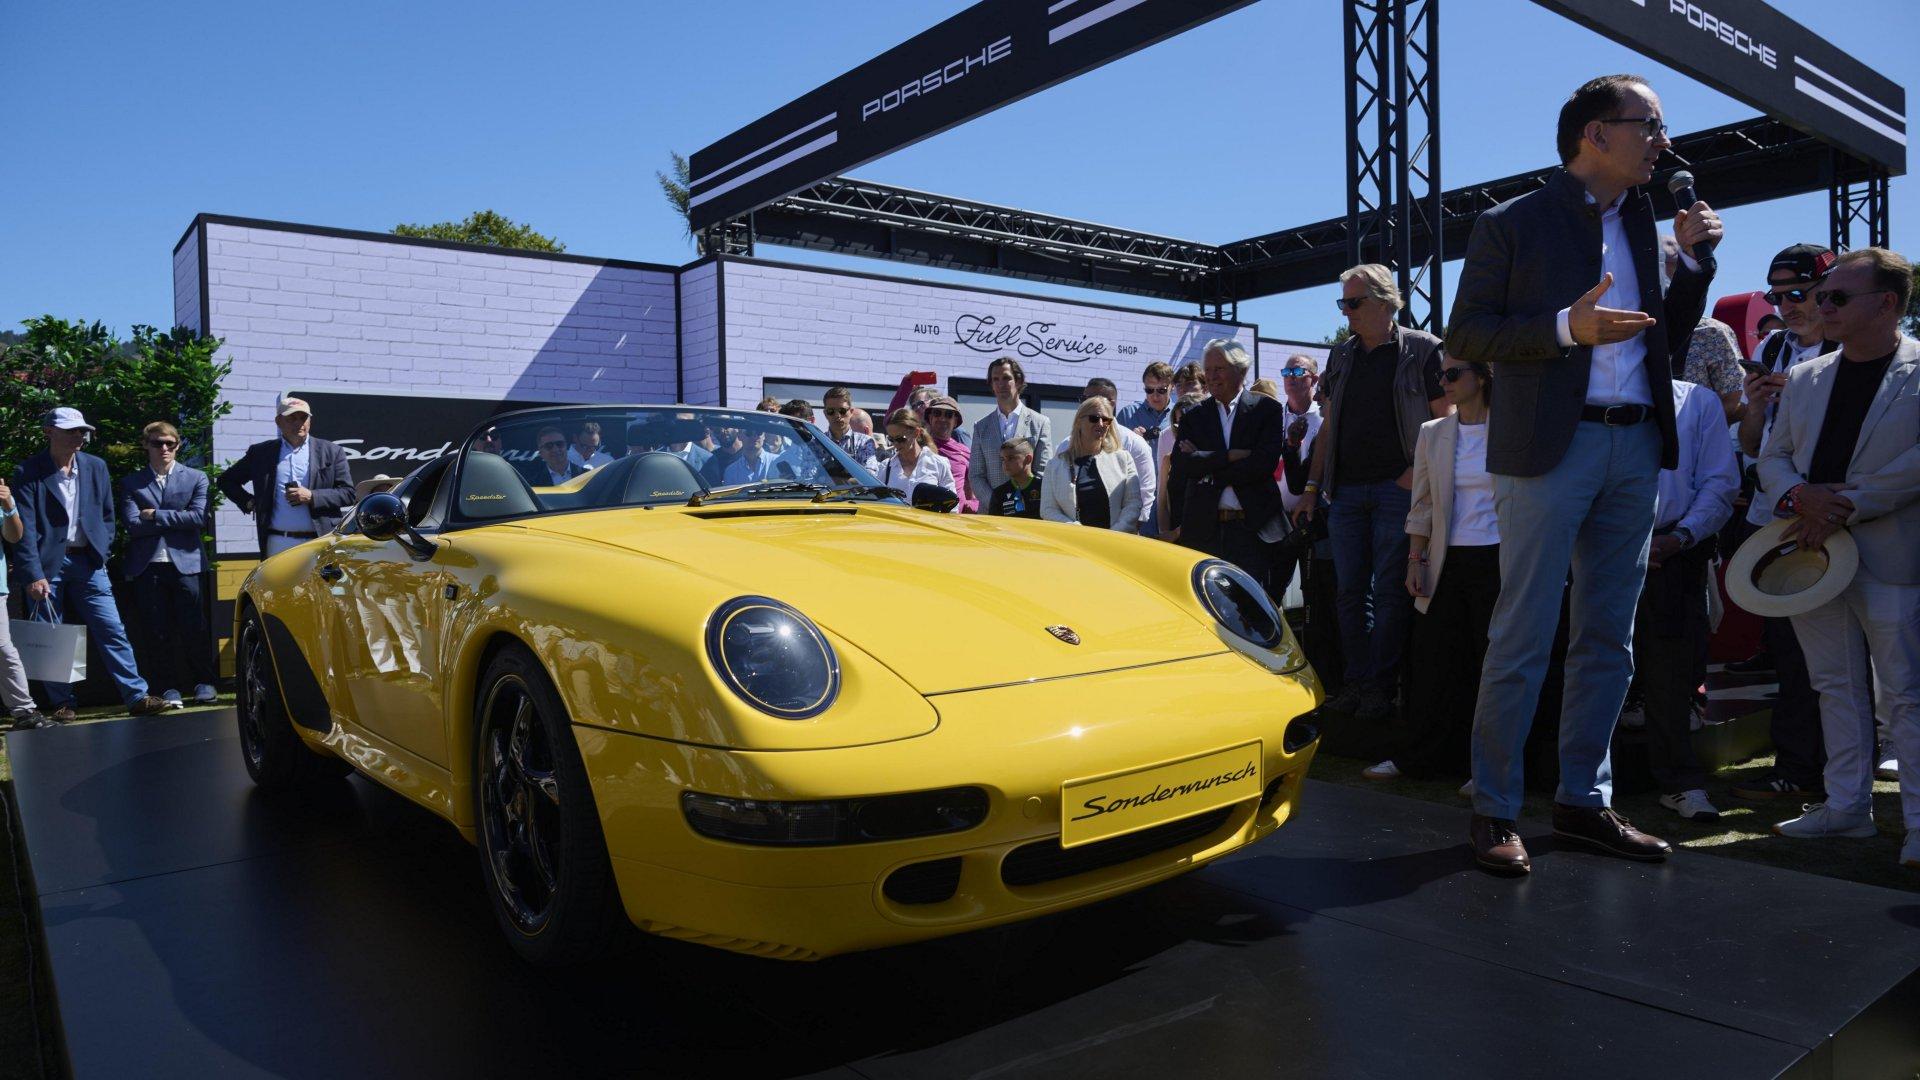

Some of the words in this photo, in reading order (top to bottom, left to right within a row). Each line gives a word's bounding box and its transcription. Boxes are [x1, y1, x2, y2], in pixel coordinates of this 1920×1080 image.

[1669, 0, 1777, 70] PORSCHE
[862, 35, 1012, 122] PORSCHE
[913, 323, 940, 336] AUTO
[954, 314, 1021, 353] Full
[1018, 321, 1107, 363] Service
[1117, 344, 1138, 355] SHOP
[466, 493, 507, 501] Speedster
[1071, 760, 1257, 822] Sonderwunsch
